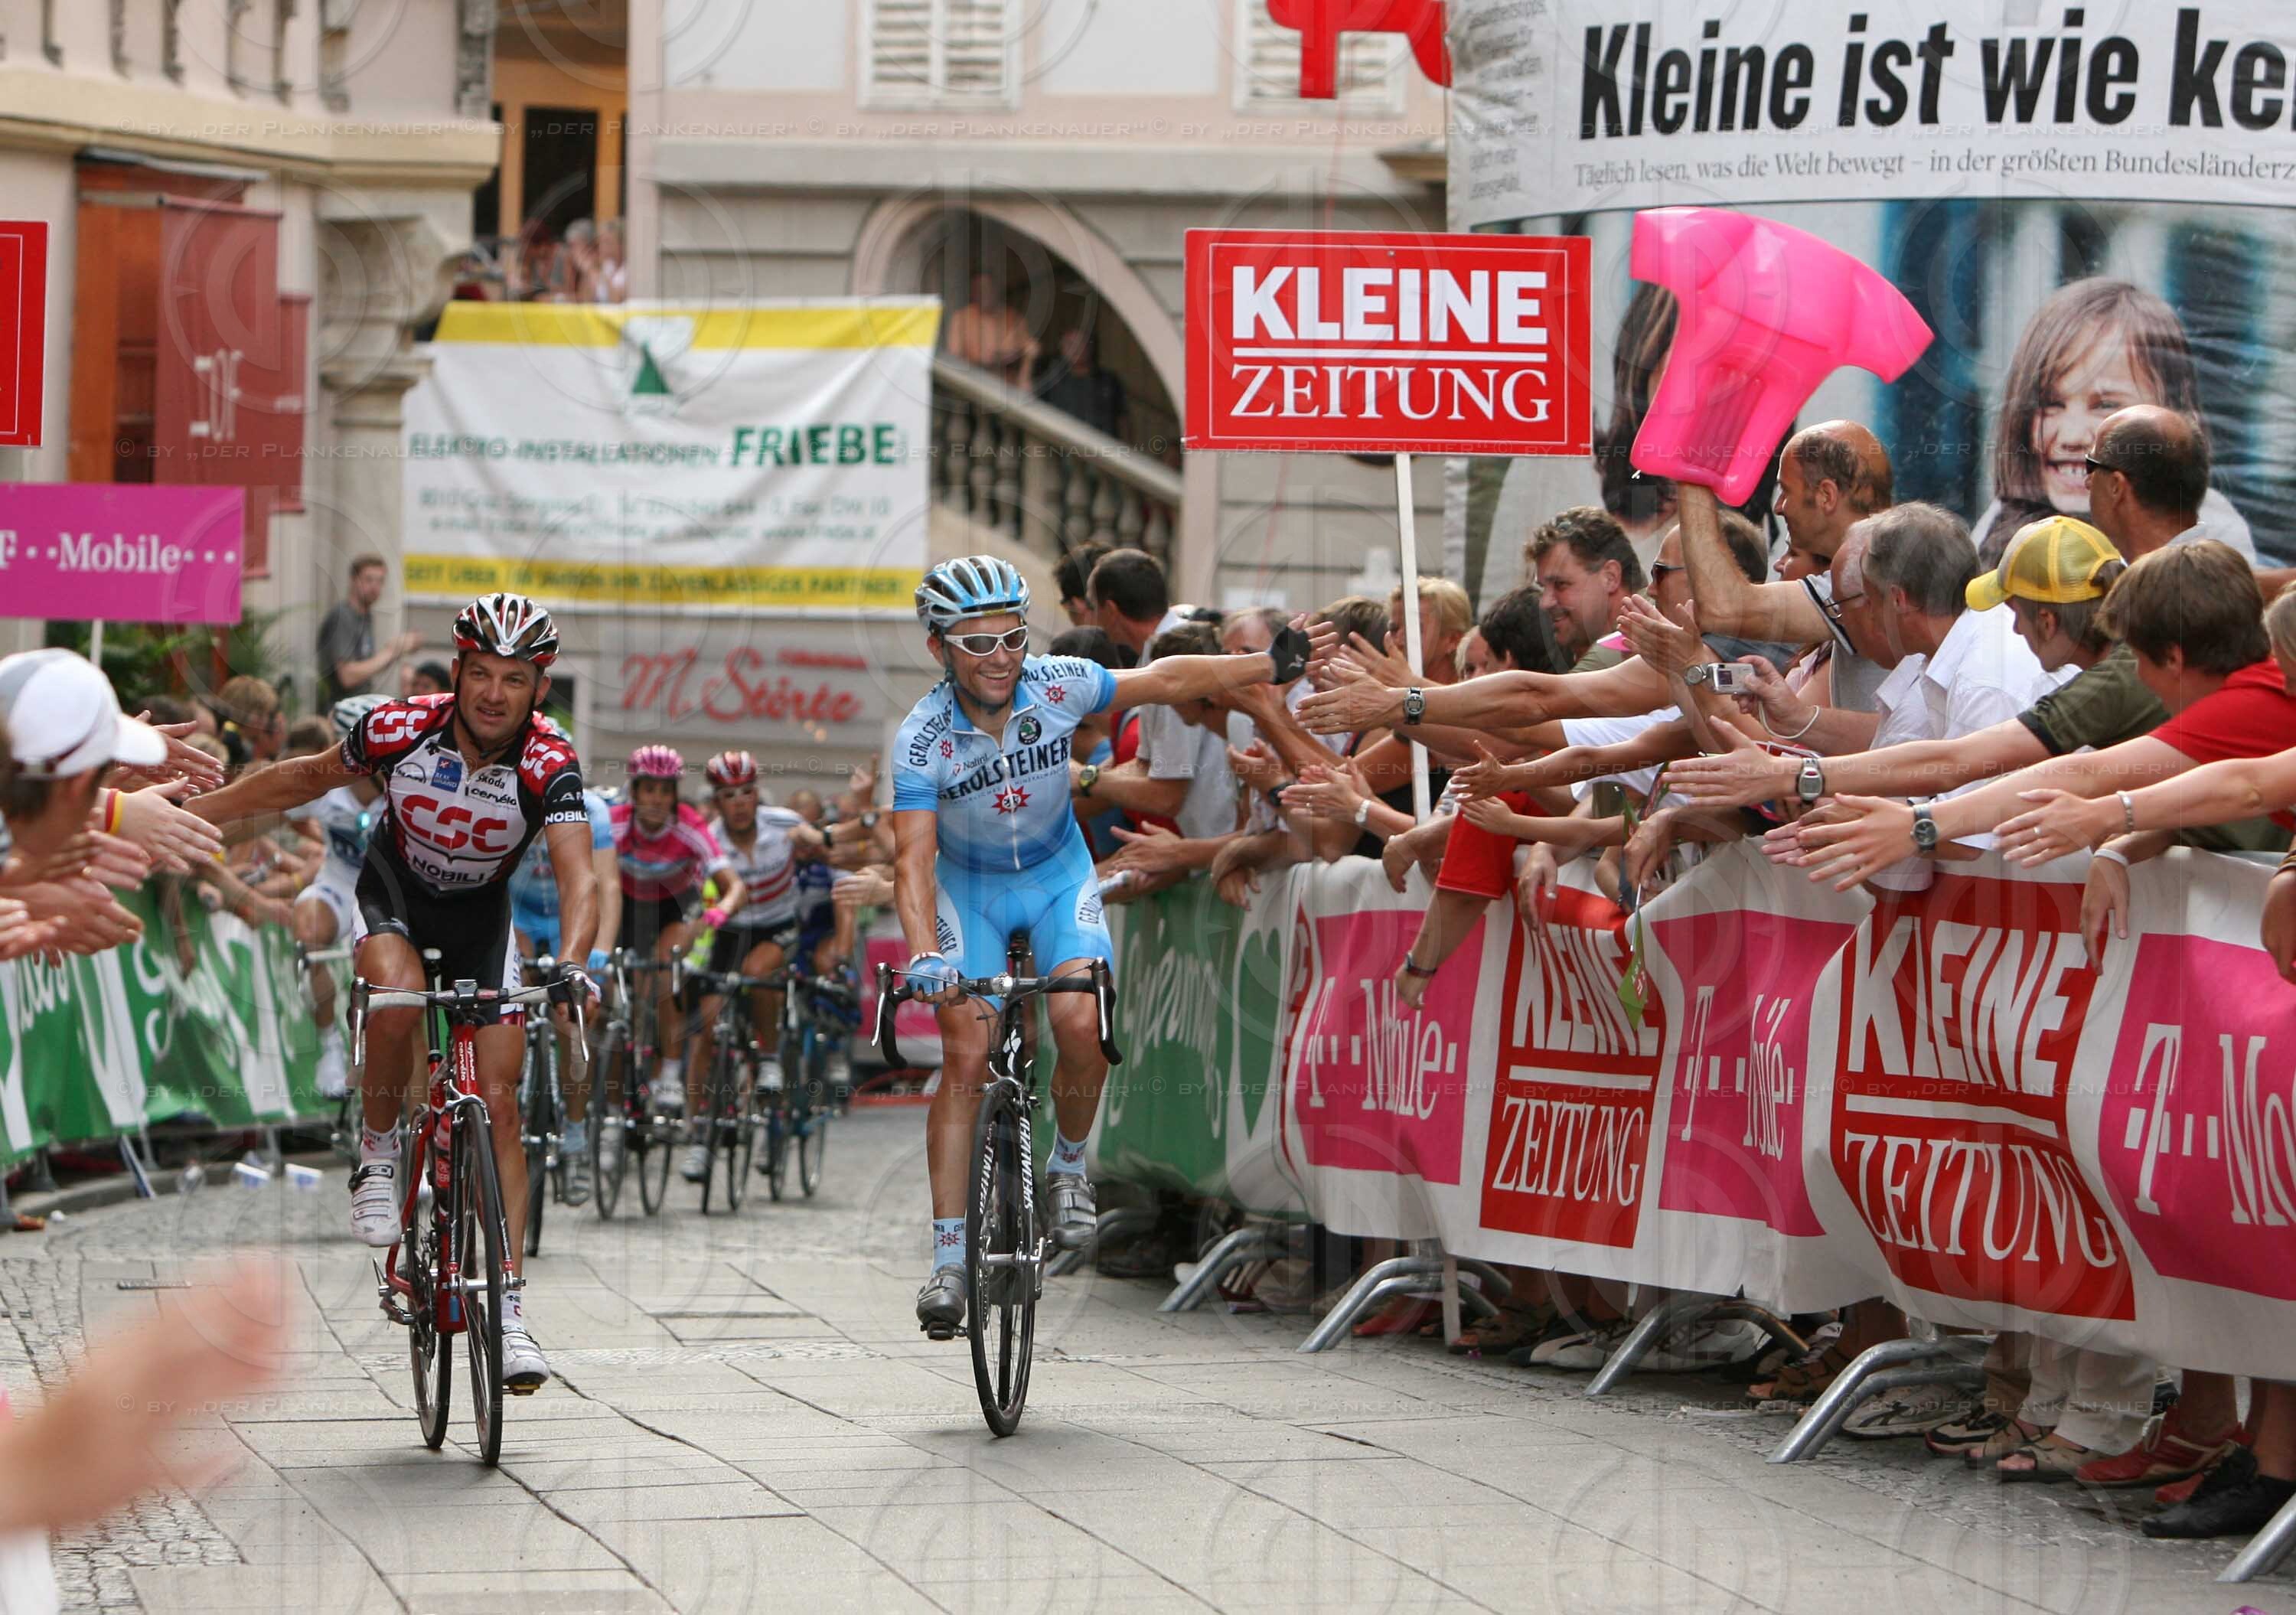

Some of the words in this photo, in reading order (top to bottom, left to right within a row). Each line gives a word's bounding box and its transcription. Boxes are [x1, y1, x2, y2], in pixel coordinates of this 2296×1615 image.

[1580, 19, 1815, 140] Kleine
[1837, 13, 1955, 127] ist
[1980, 8, 2139, 125] wie
[2168, 8, 2296, 132] ke
[1574, 158, 1635, 190] Täglich
[1639, 158, 1690, 183] lesen,
[1697, 163, 1733, 178] was
[1737, 154, 1768, 178] die
[1775, 152, 1821, 175] Welt
[1827, 153, 1904, 177] bewegt
[1929, 152, 1951, 172] in
[1956, 148, 1995, 172] der
[2001, 146, 2097, 177] größten
[1232, 265, 1548, 344] KLEINE
[1230, 363, 1550, 423] ZEITUNG
[731, 423, 898, 466] FRIEBE
[367, 710, 428, 744] CSC
[401, 794, 508, 853] CSC
[413, 855, 484, 883] NOBILI
[1848, 914, 2090, 1098] KLEINE
[1019, 1116, 1033, 1213] SPECIALIZED
[1492, 1094, 1645, 1206] ZEITUNG
[1845, 1128, 2117, 1268] ZEITUNG
